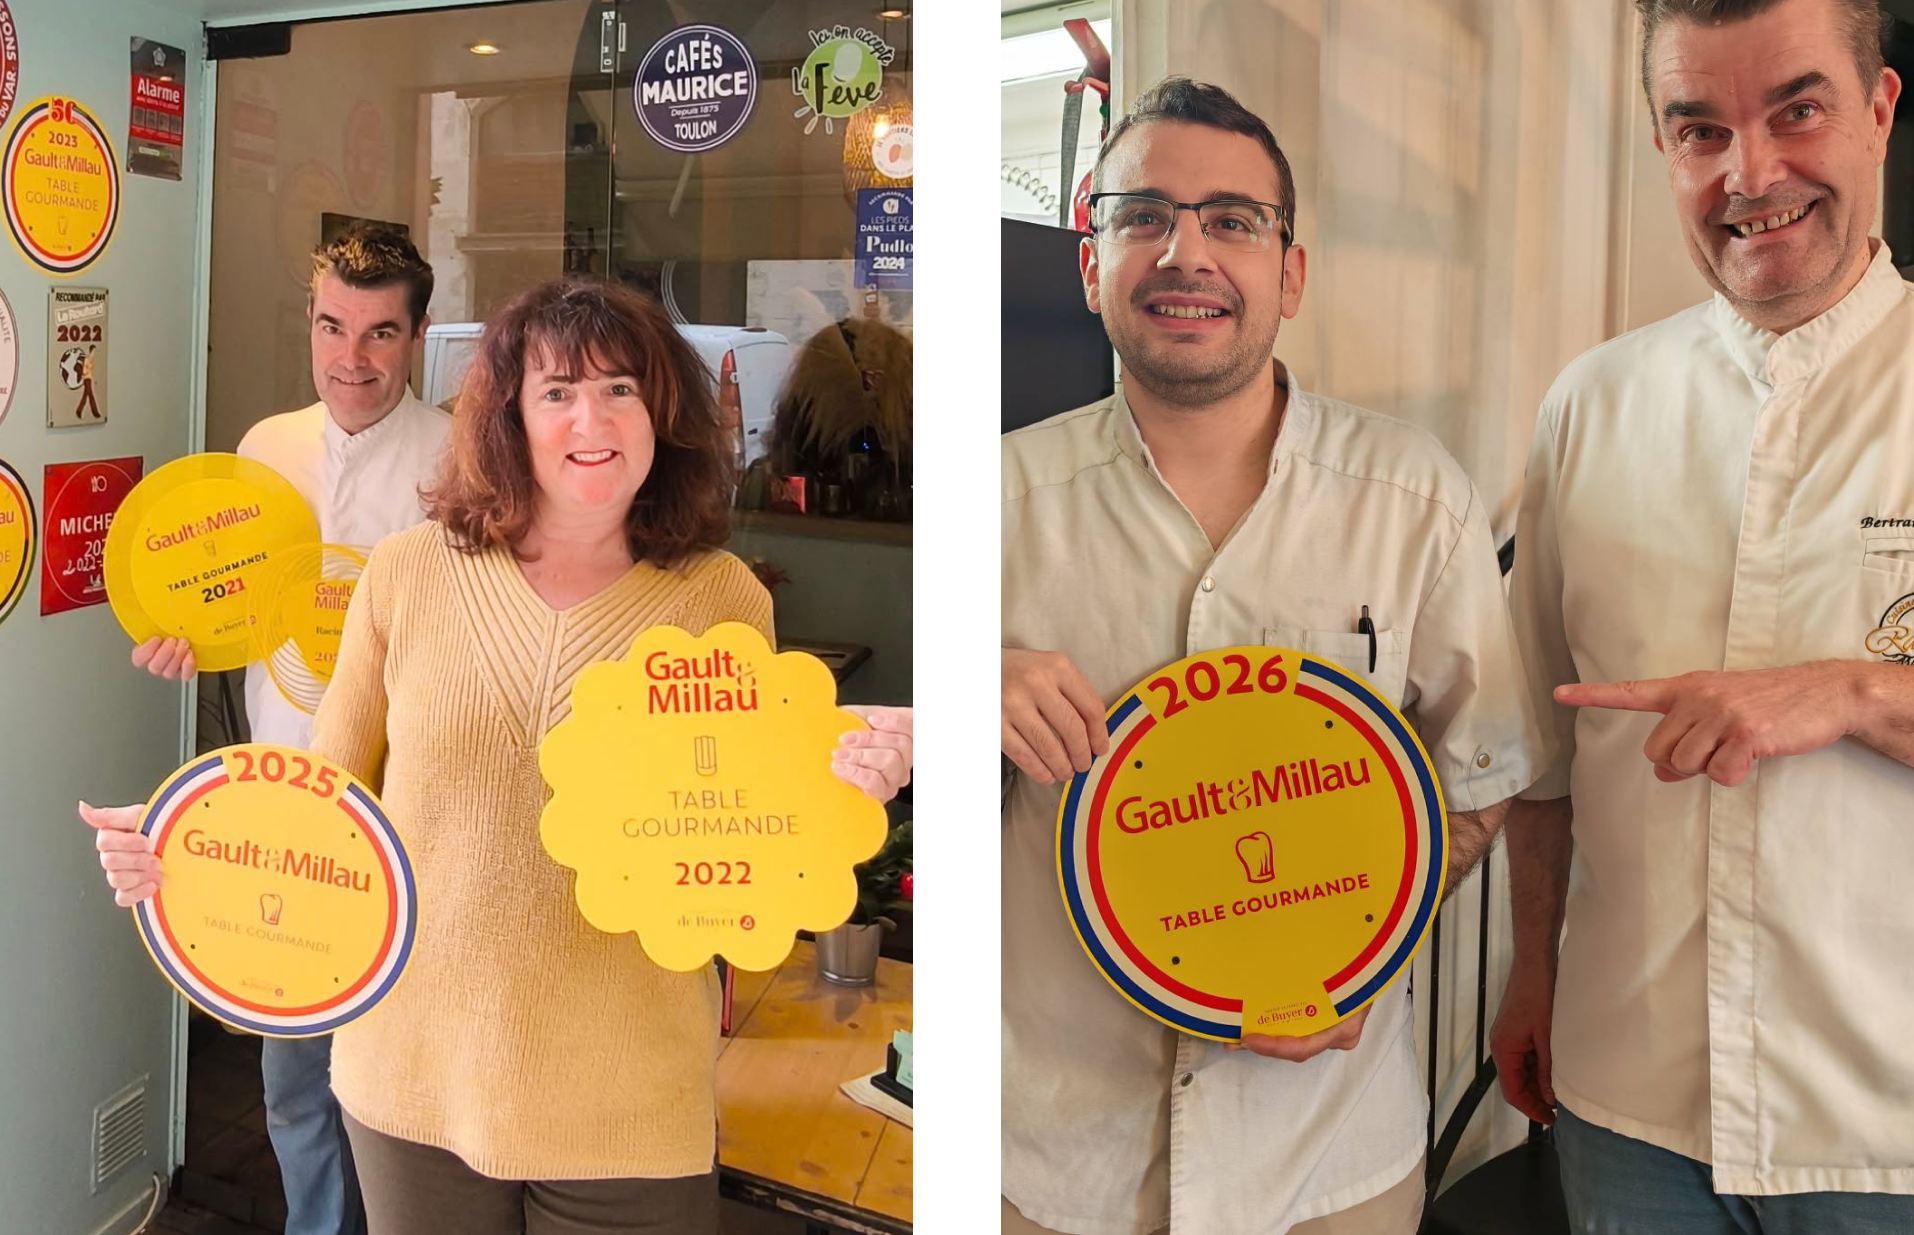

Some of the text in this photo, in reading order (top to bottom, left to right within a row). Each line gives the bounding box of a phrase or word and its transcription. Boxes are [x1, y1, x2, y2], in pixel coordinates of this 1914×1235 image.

[665, 33, 723, 74] CAFÉS
[834, 26, 849, 39] on
[855, 28, 894, 65] accepte
[2, 71, 17, 101] VAR
[137, 77, 180, 103] Alarme
[642, 70, 749, 106] MAURICE
[793, 67, 810, 93] La
[671, 107, 698, 117] Depuis
[48, 130, 78, 148] 2023
[674, 120, 718, 140] TOULON
[46, 177, 79, 194] TABLE
[25, 189, 99, 212] GOURMANDE
[860, 224, 884, 232] DANS
[886, 224, 896, 232] LE
[871, 216, 885, 224] LES
[866, 235, 913, 253] Pudlo
[872, 256, 905, 270] 2024
[56, 324, 103, 342] 2022
[60, 511, 114, 537] MICHE
[167, 551, 269, 593] TABLE GOURMANDE
[201, 577, 246, 604] 2021
[315, 582, 353, 598] Gault
[314, 595, 349, 611] Milla
[648, 682, 758, 715] Millau
[1146, 653, 1288, 719] 2026
[232, 750, 339, 799] 2025
[667, 788, 748, 811] TABLE
[622, 814, 800, 839] GOURMANDE
[674, 861, 752, 886] 2022
[1159, 873, 1371, 932] TABLE GOURMANDE
[202, 915, 333, 955] TABLE GOURMANDE
[1257, 1015, 1270, 1025] de
[1271, 1008, 1303, 1023] Buyer
